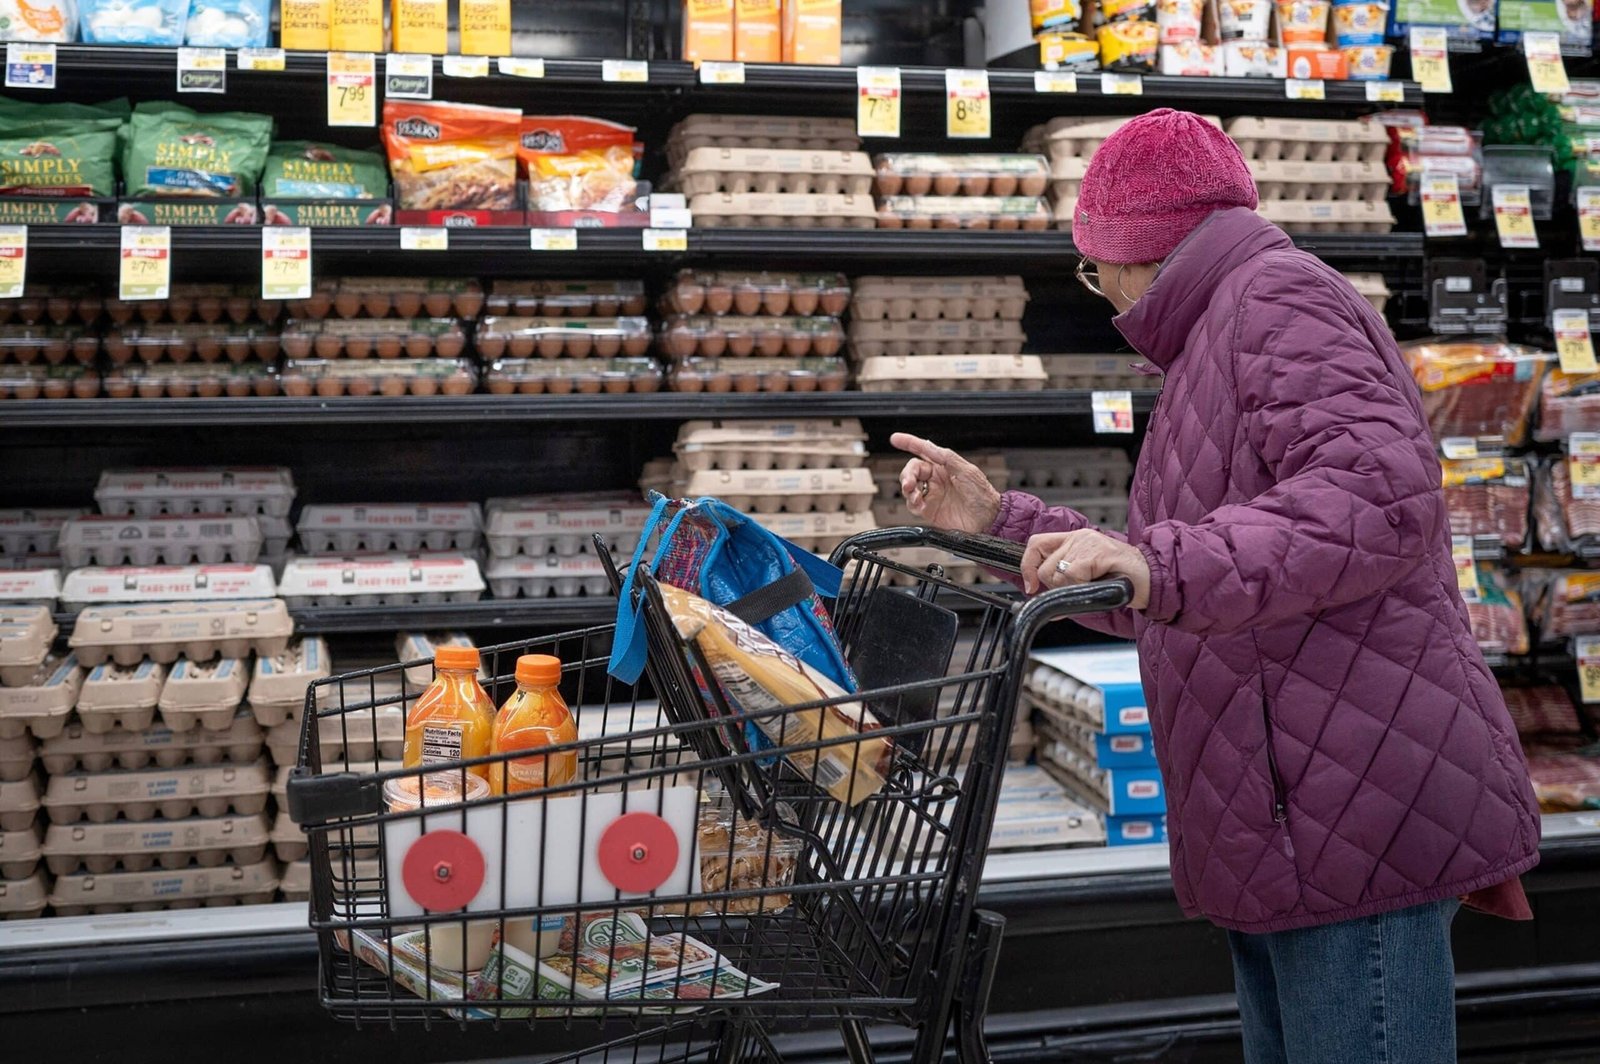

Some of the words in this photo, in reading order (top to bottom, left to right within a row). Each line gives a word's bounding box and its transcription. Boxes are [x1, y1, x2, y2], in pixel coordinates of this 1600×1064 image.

[286, 10, 319, 19] from
[334, 7, 368, 15] from
[401, 10, 435, 19] from
[334, 17, 379, 26] plants
[465, 13, 498, 21] from
[284, 21, 329, 29] plants
[401, 21, 444, 29] plants
[464, 23, 507, 32] plants
[156, 143, 232, 163] SIMPLY
[1, 158, 80, 174] SIMPLY
[156, 156, 231, 174] POTATOES
[283, 161, 353, 175] SIMPLY
[5, 174, 82, 185] POTATOES
[0, 203, 57, 216] IMPLY
[155, 204, 218, 217] SIMPLY
[297, 205, 359, 218] SIMPLY
[0, 215, 58, 223] OTATOES
[450, 749, 460, 757] 120
